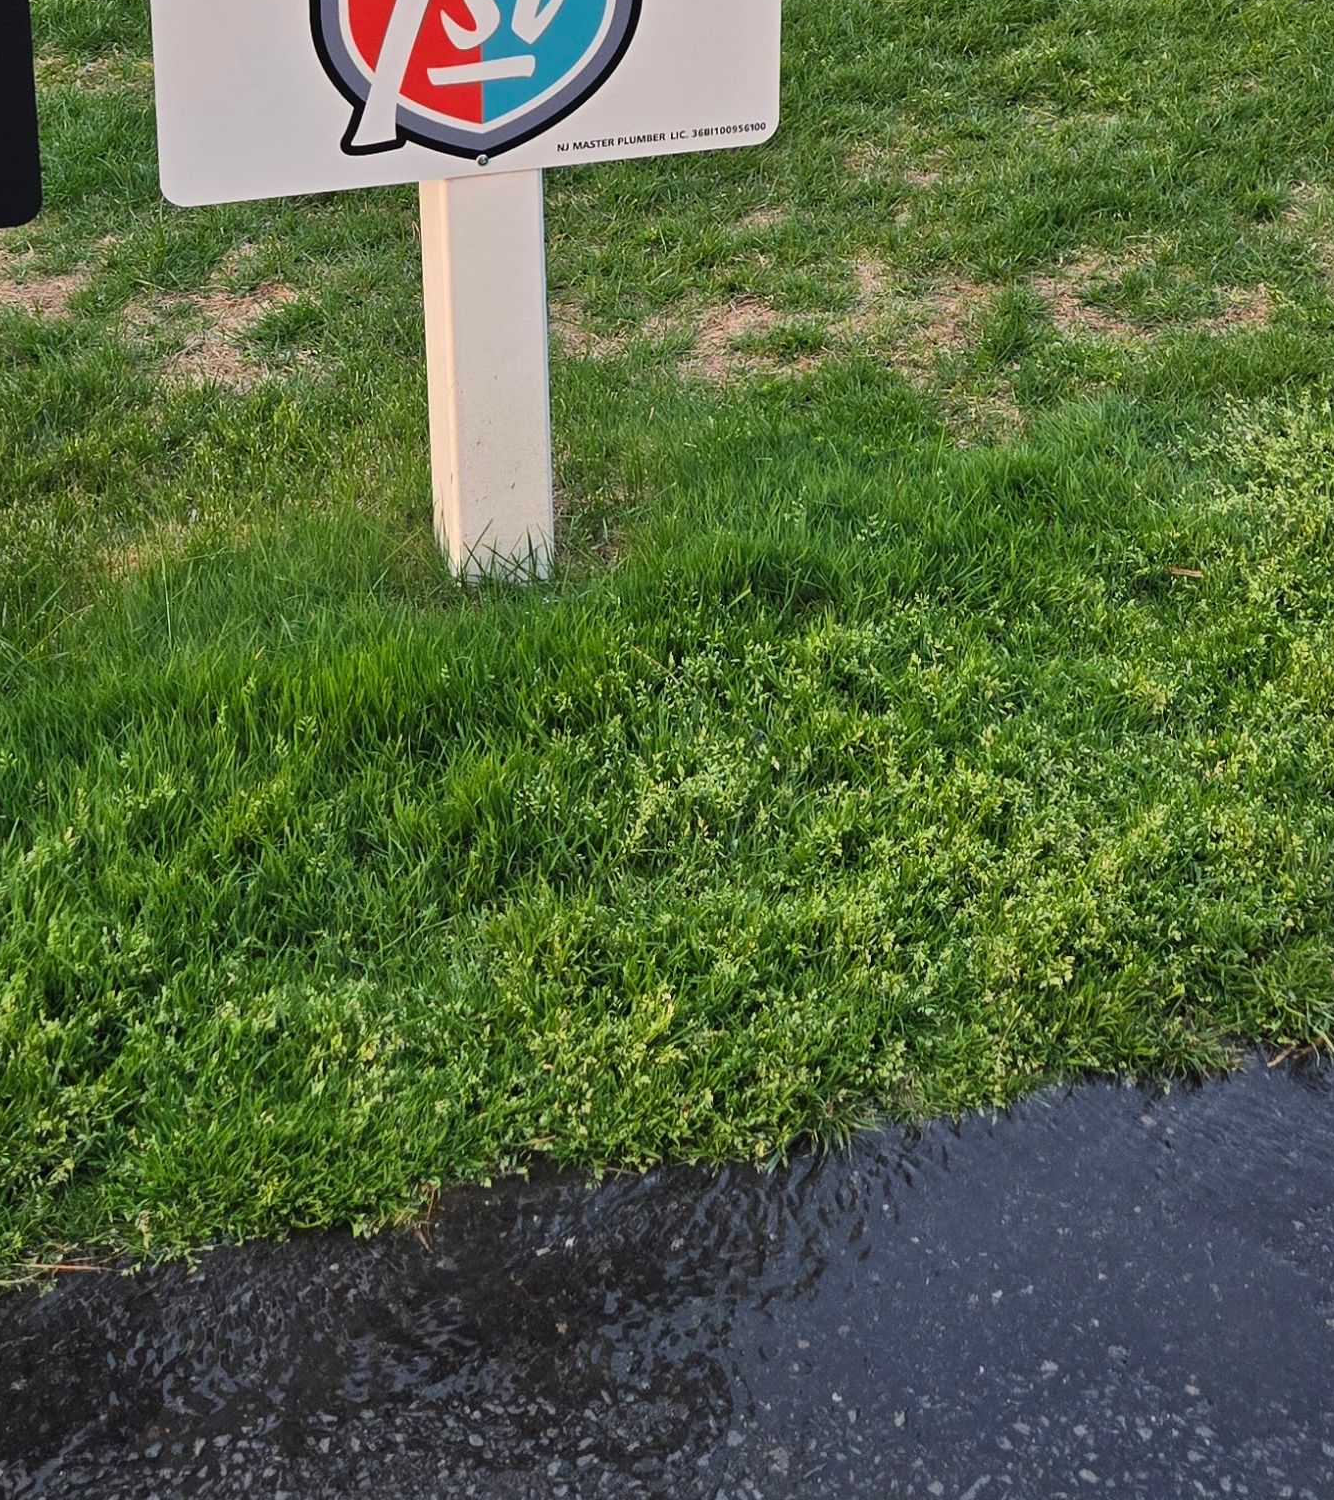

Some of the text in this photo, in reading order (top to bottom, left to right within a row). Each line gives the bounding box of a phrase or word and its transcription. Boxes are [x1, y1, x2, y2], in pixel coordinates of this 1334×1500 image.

[557, 143, 570, 152] NJ
[573, 138, 615, 150] MASTER
[617, 133, 666, 146] PLUMBER
[670, 131, 689, 140] LIC.
